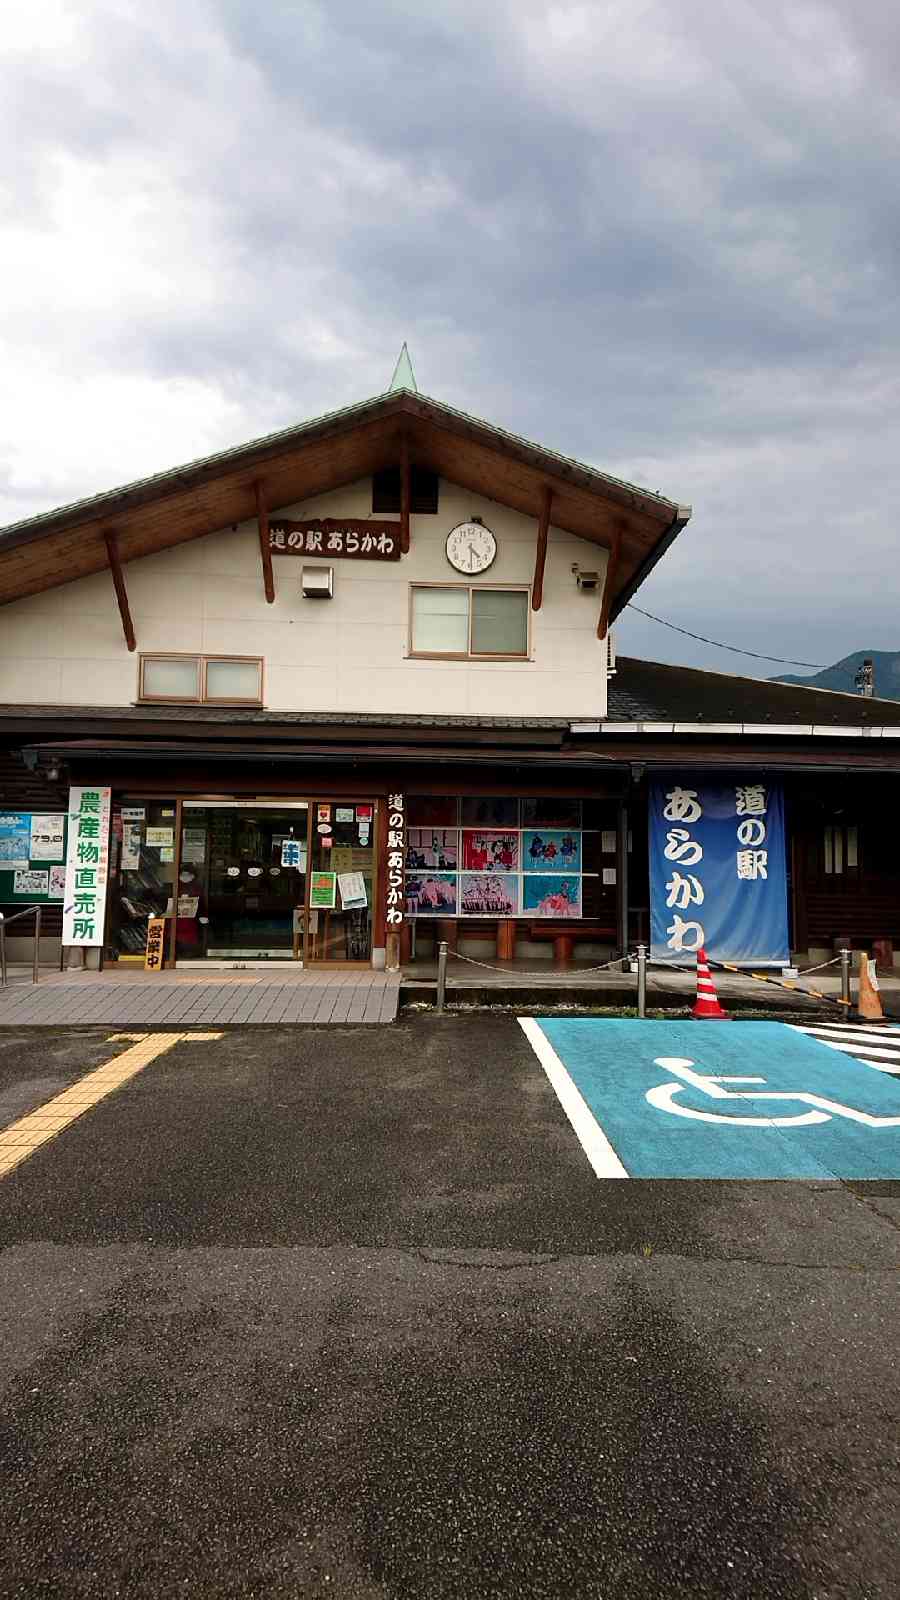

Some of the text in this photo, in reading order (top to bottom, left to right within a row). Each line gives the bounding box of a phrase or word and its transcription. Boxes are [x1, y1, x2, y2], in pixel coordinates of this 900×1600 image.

[269, 529, 395, 553] 道の駅あらかわ
[32, 834, 63, 843] 79.0
[72, 791, 101, 940] 農産物直売所
[386, 794, 404, 924] 道の駅あらかわ
[663, 786, 705, 952] あらかわ
[735, 784, 768, 880] 道の駅
